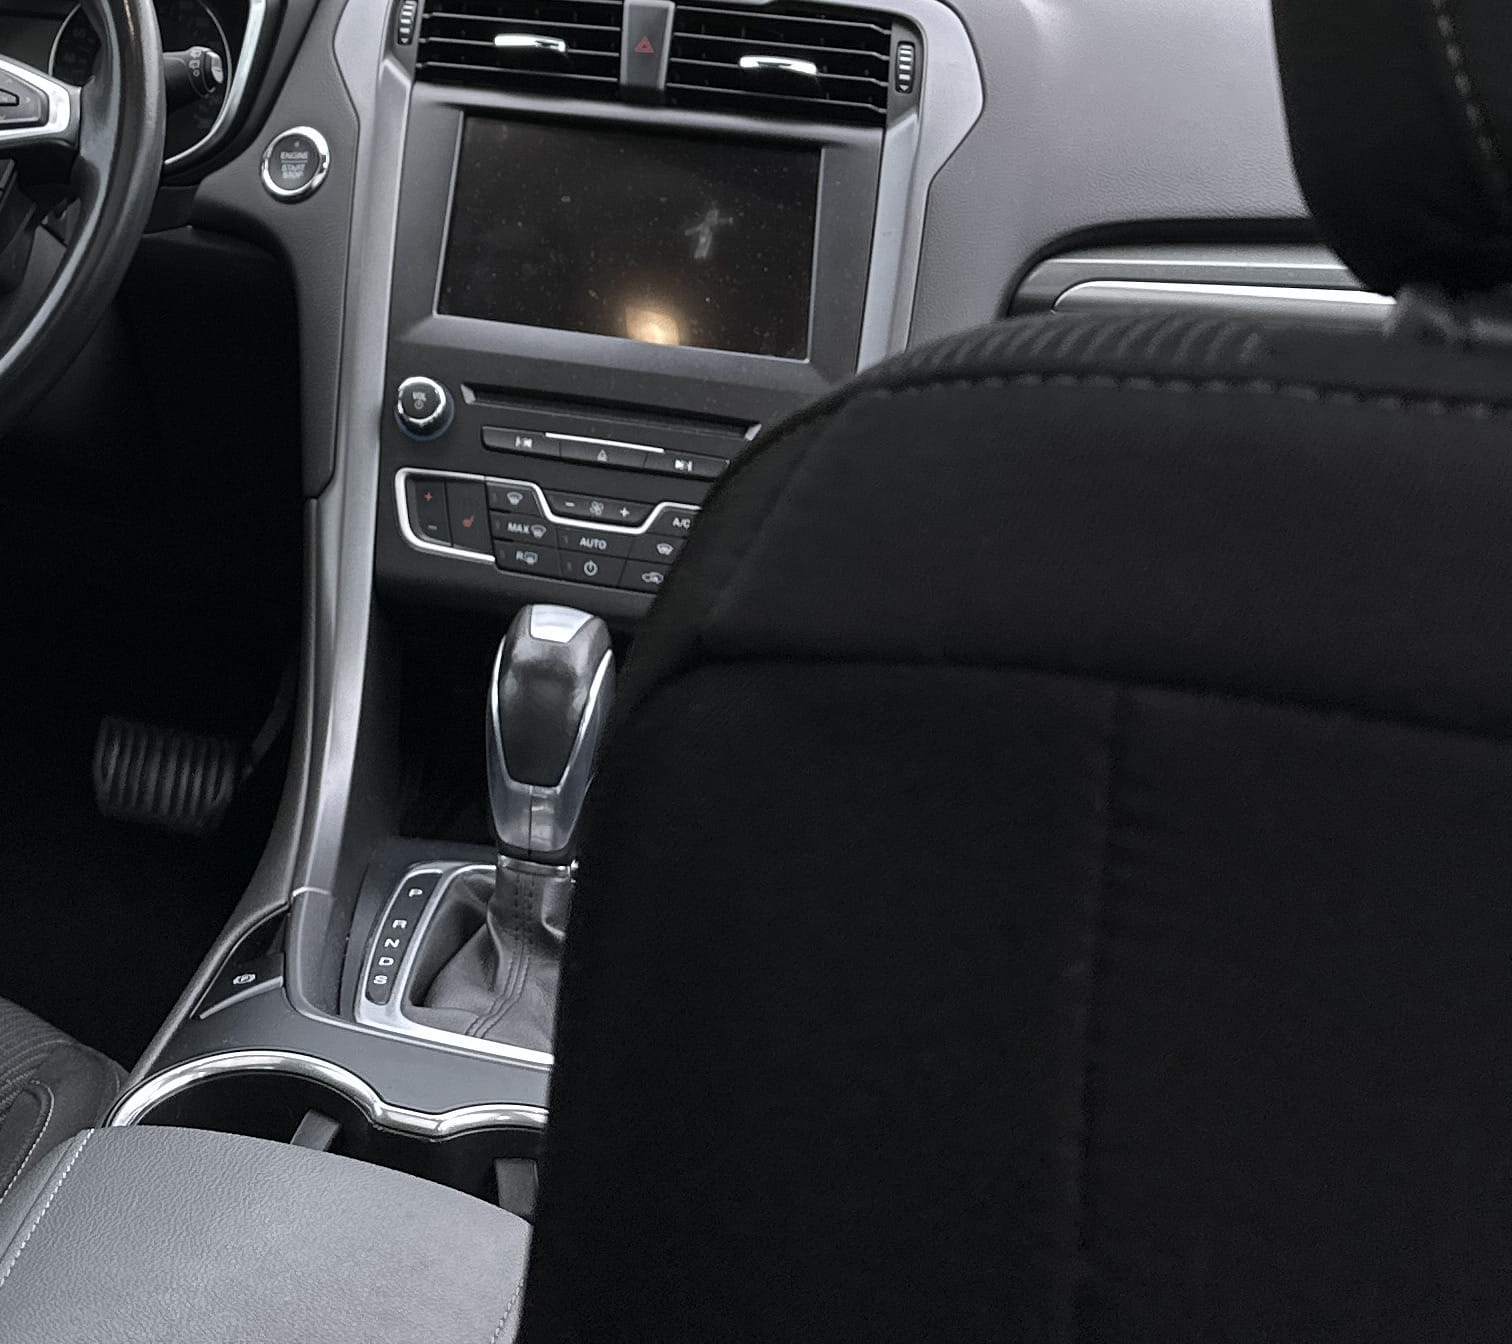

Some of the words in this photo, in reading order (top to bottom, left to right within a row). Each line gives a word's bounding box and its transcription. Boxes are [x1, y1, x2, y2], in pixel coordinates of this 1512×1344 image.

[507, 522, 530, 535] MAX
[672, 518, 691, 529] A/C
[579, 537, 607, 550] AUTO
[408, 888, 423, 898] P
[392, 919, 408, 929] R
[384, 938, 400, 948] N
[378, 957, 394, 966] D
[373, 975, 388, 985] S
